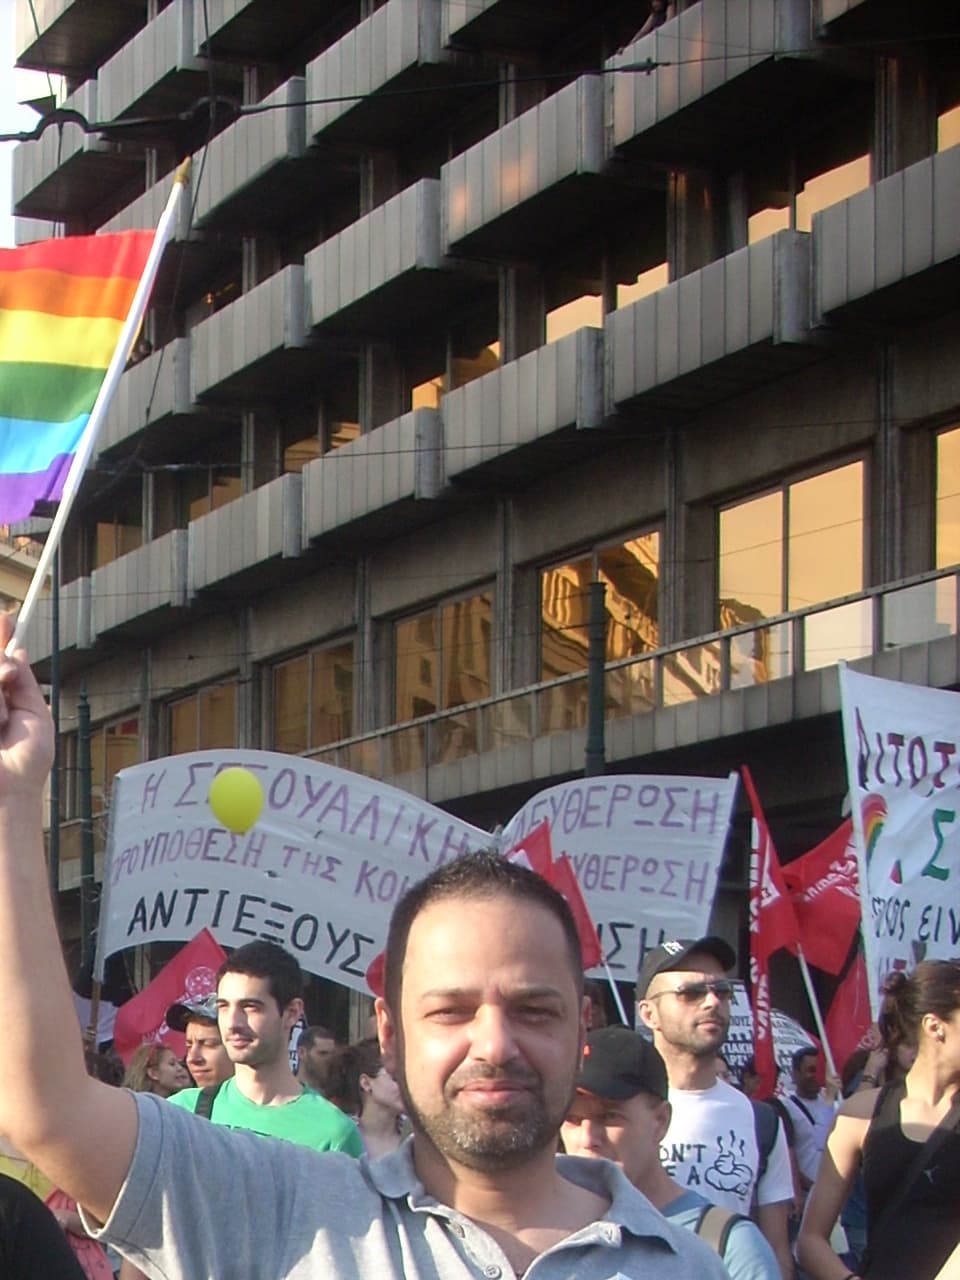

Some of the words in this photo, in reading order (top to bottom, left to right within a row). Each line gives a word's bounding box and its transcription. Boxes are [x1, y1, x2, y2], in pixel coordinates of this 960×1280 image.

[174, 762, 470, 866] ΣΟΥΑΛΙΚΗ
[283, 845, 342, 883] ΤΗΣ
[658, 1144, 707, 1163] ON'T
